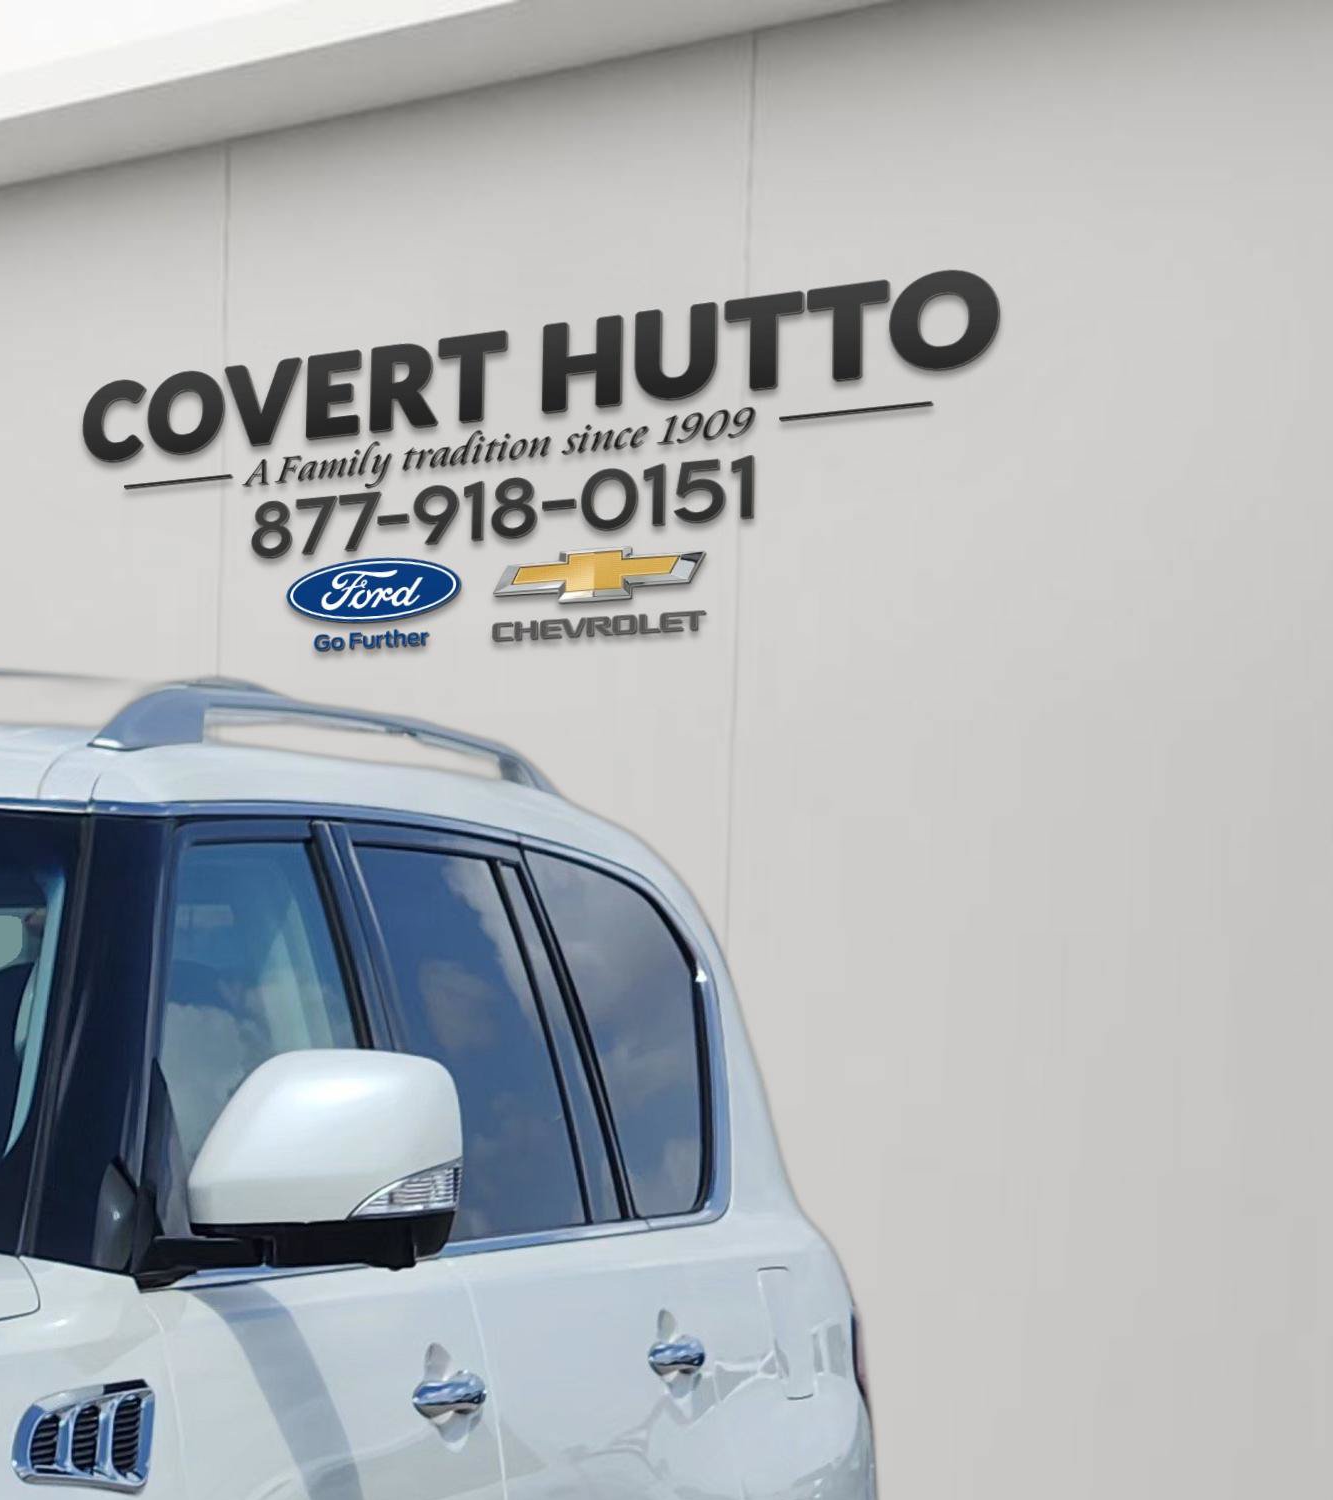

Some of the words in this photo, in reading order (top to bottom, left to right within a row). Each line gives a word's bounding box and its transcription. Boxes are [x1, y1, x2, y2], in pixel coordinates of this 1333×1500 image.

[81, 329, 509, 465] COVERT
[541, 269, 1001, 415] HUTTO
[243, 459, 269, 488] A
[275, 441, 392, 489] Family
[402, 429, 551, 472] tradition
[561, 424, 649, 456] since
[657, 406, 756, 446] 1909
[250, 455, 755, 559] 877-918-0151
[320, 569, 423, 611] Ford
[314, 634, 345, 653] Go
[349, 628, 430, 651] Further
[491, 610, 707, 643] CHEVROLET
